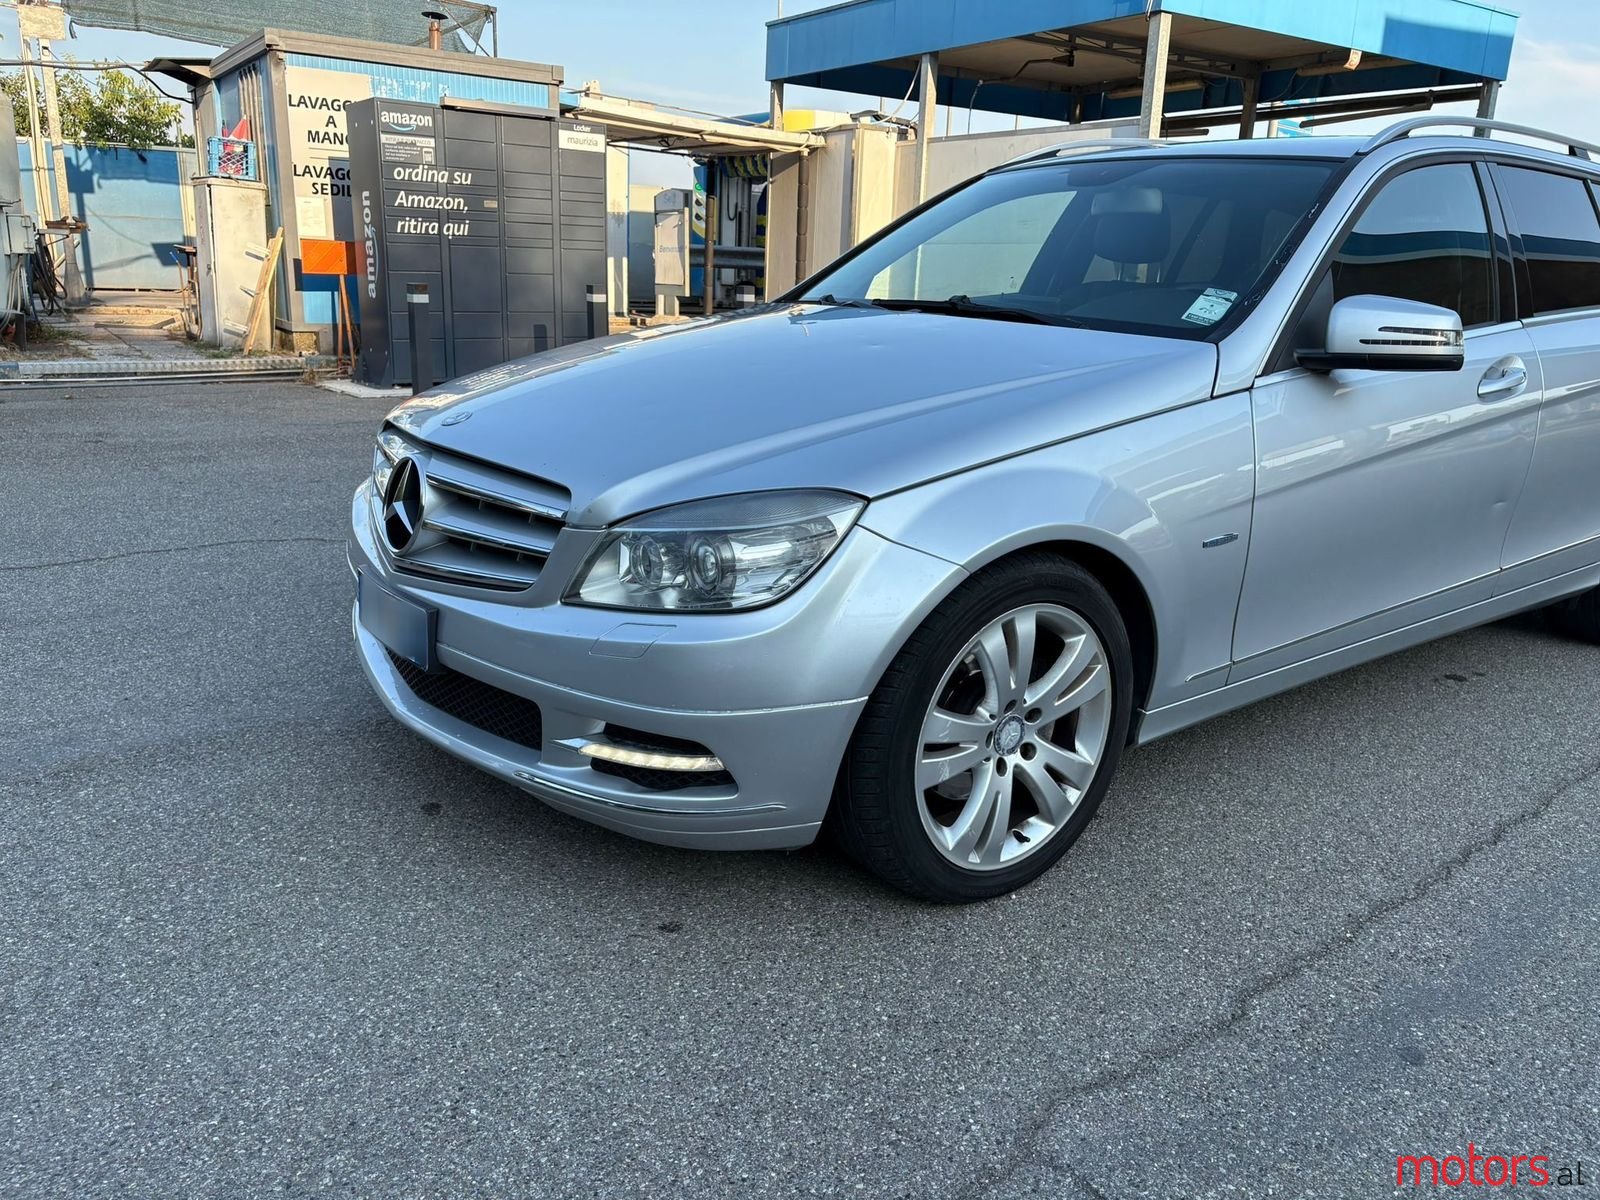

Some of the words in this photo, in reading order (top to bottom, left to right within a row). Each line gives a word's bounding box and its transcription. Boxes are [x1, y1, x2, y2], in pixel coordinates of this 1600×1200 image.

[325, 115, 337, 128] A
[381, 111, 432, 127] amazon
[307, 130, 348, 145] MAN
[567, 136, 598, 147] maurizia
[393, 165, 448, 183] ordina
[453, 171, 472, 184] su
[394, 190, 468, 213] Amazon,
[397, 217, 438, 235] ritira
[443, 220, 469, 239] qui
[362, 191, 376, 298] amazon
